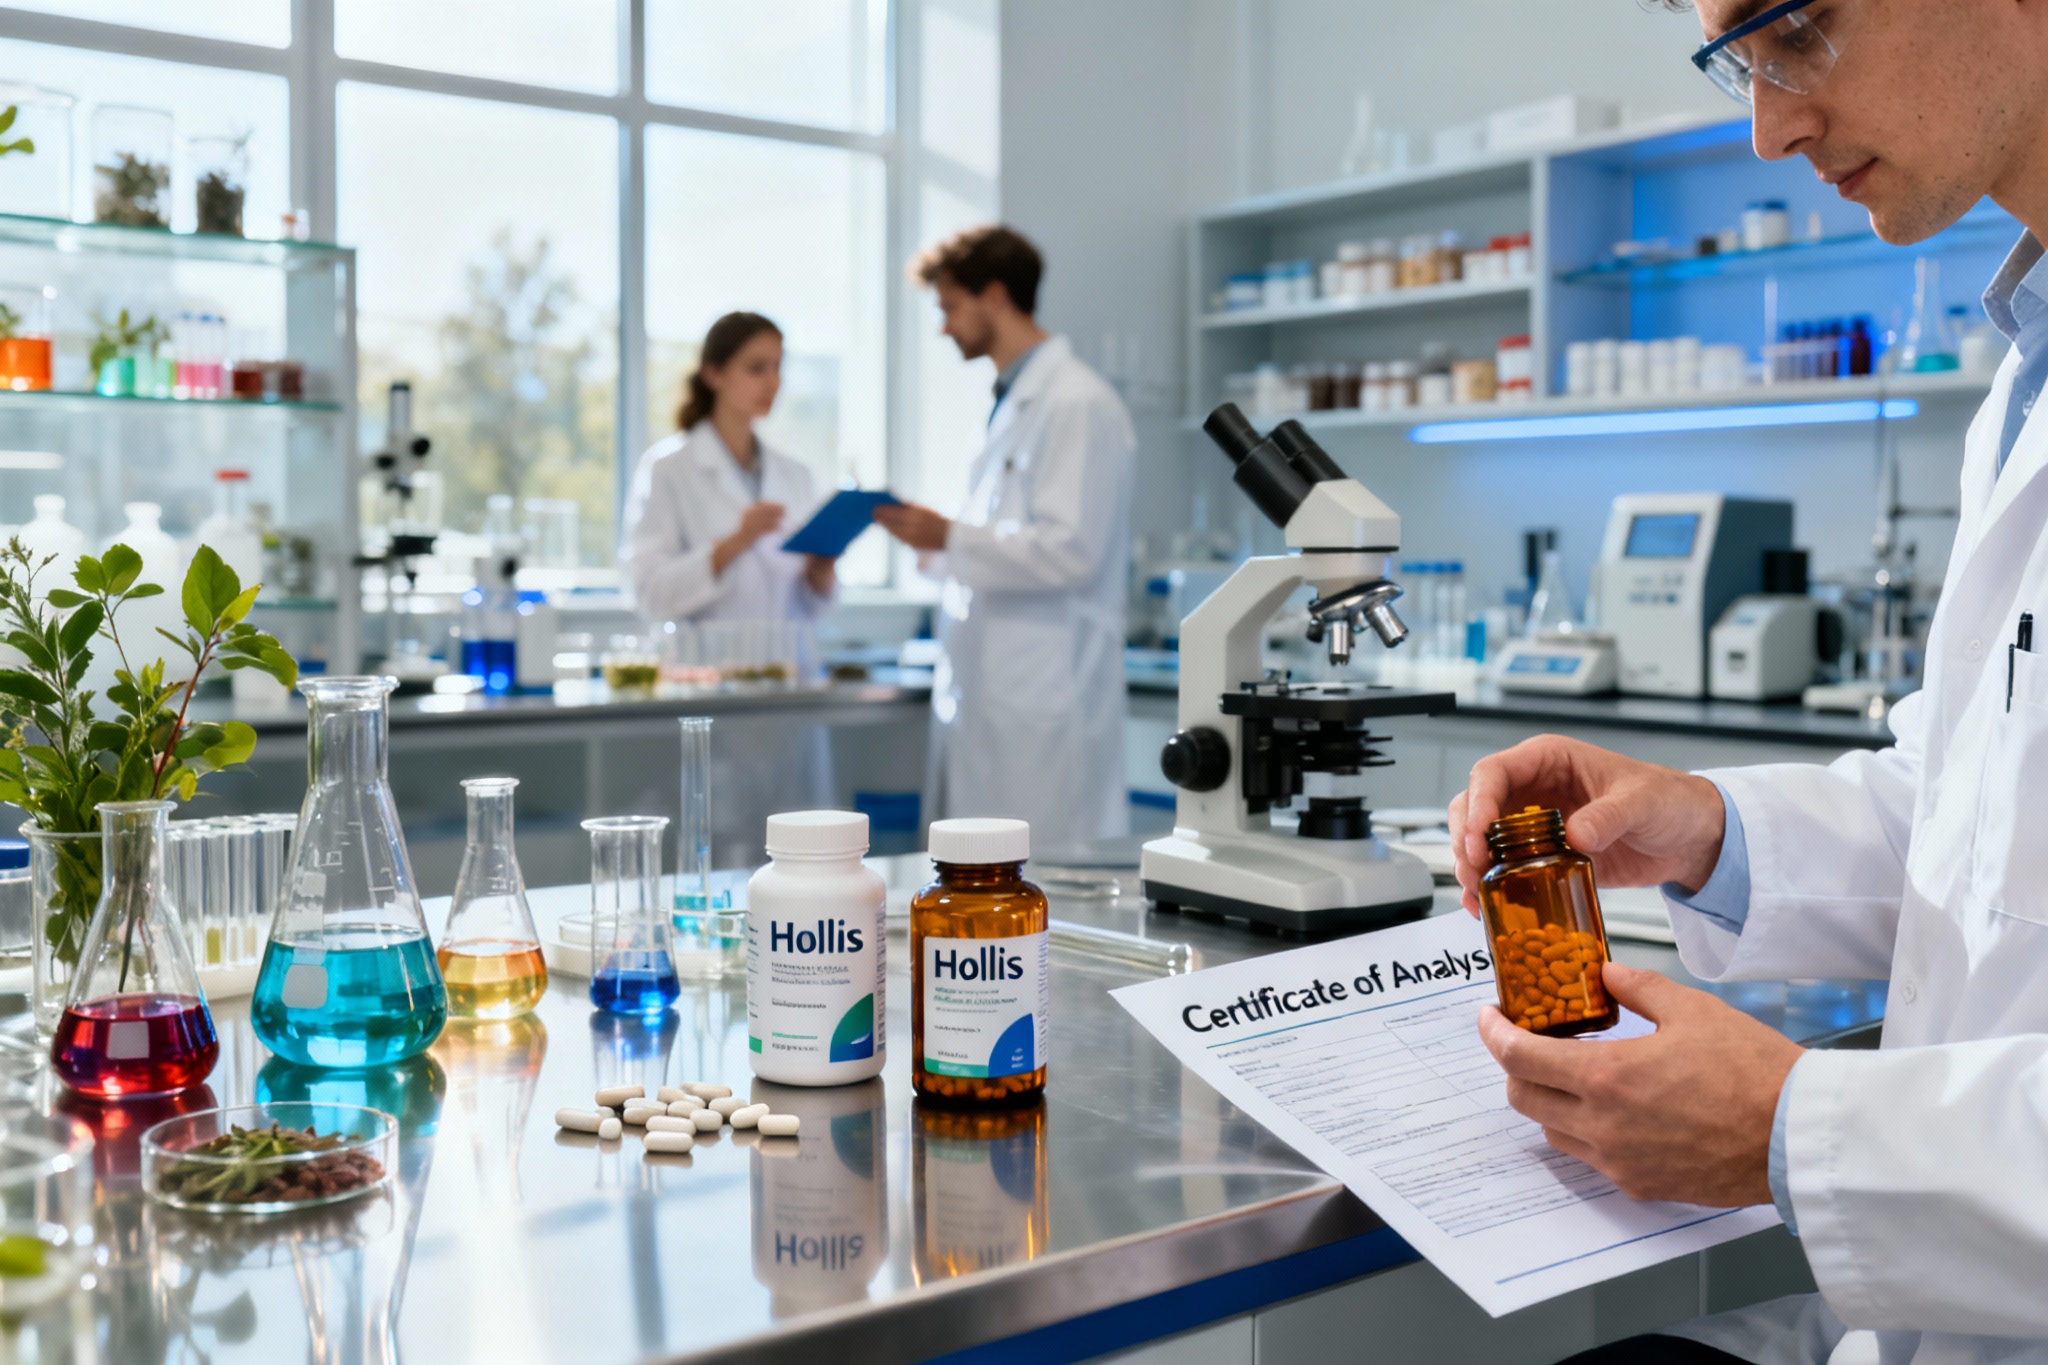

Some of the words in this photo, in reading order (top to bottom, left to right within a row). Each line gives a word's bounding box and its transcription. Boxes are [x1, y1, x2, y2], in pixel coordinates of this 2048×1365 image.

[770, 918, 864, 954] Hollis
[934, 945, 1024, 981] Hollis
[1182, 978, 1348, 1032] Certificate
[1353, 964, 1385, 995] of
